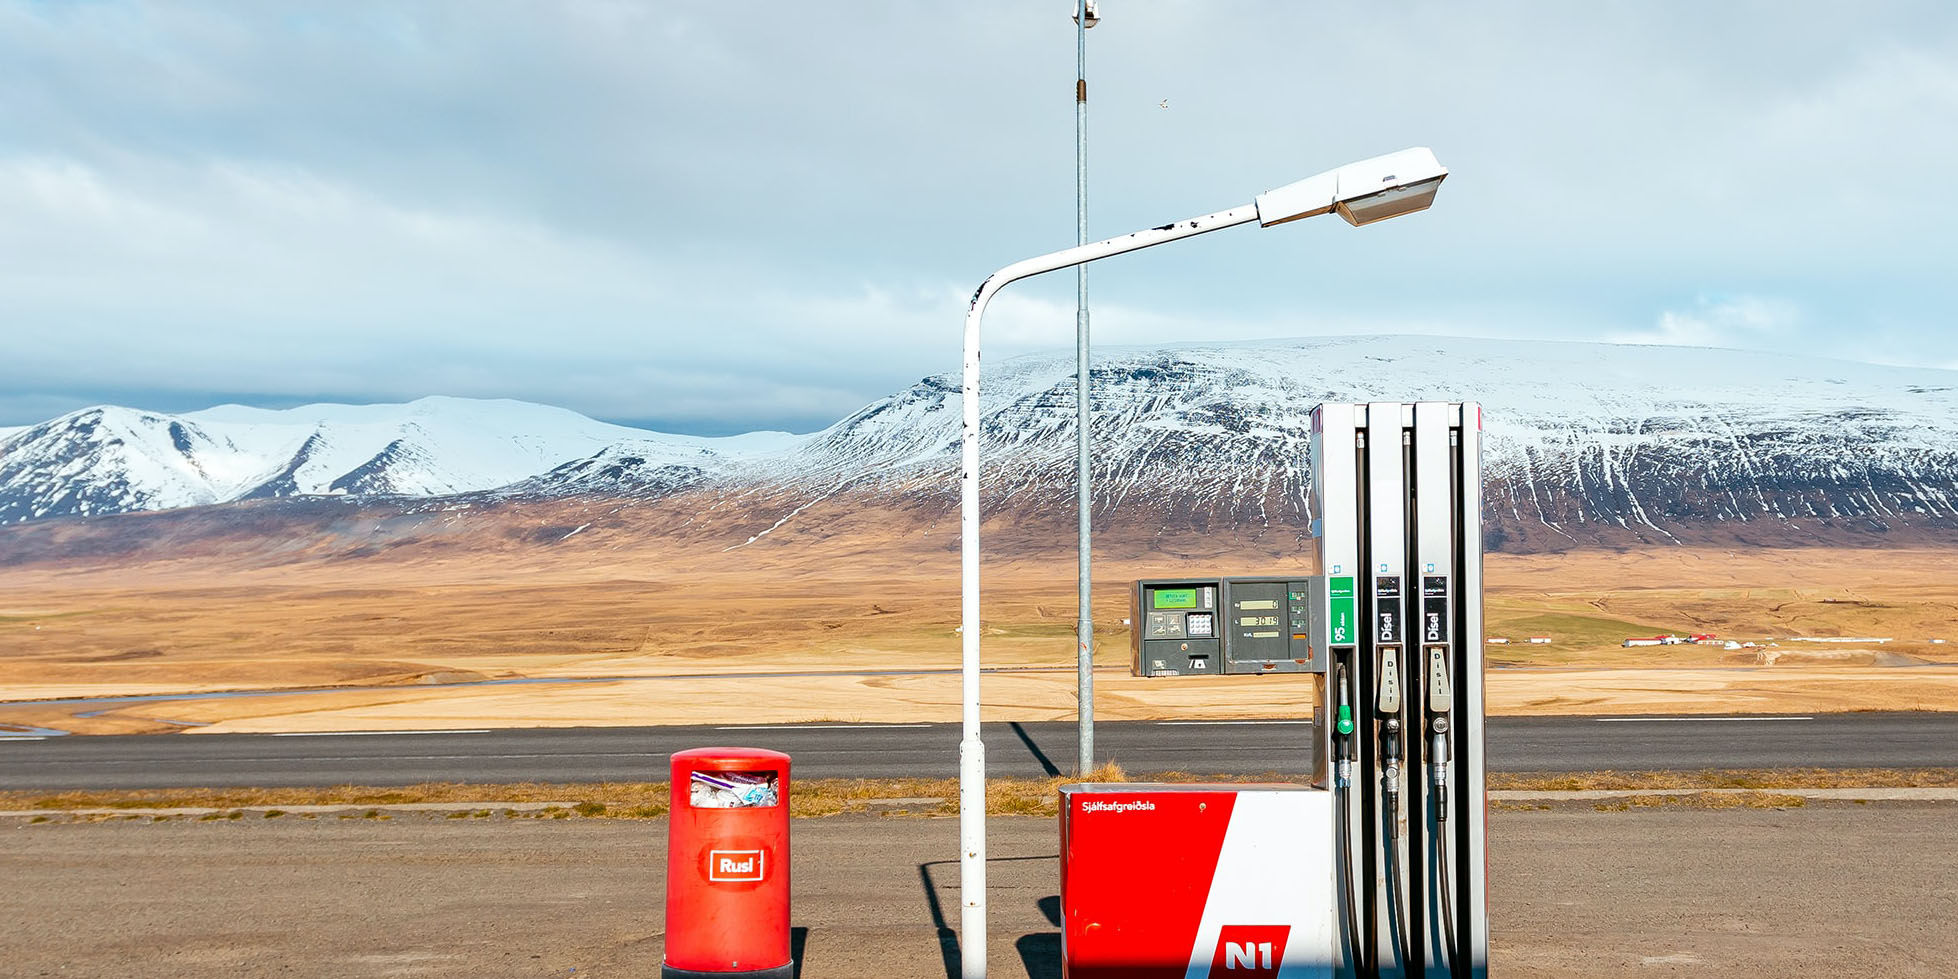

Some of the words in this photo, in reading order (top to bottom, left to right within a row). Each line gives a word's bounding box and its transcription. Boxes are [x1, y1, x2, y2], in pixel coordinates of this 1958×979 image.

[1334, 626, 1346, 642] 95
[1380, 612, 1393, 641] Dísel
[1427, 612, 1440, 641] Dísel
[1082, 800, 1156, 815] Sjálfsafgreiðsla
[720, 857, 754, 873] Rusl
[1225, 942, 1272, 970] N1
